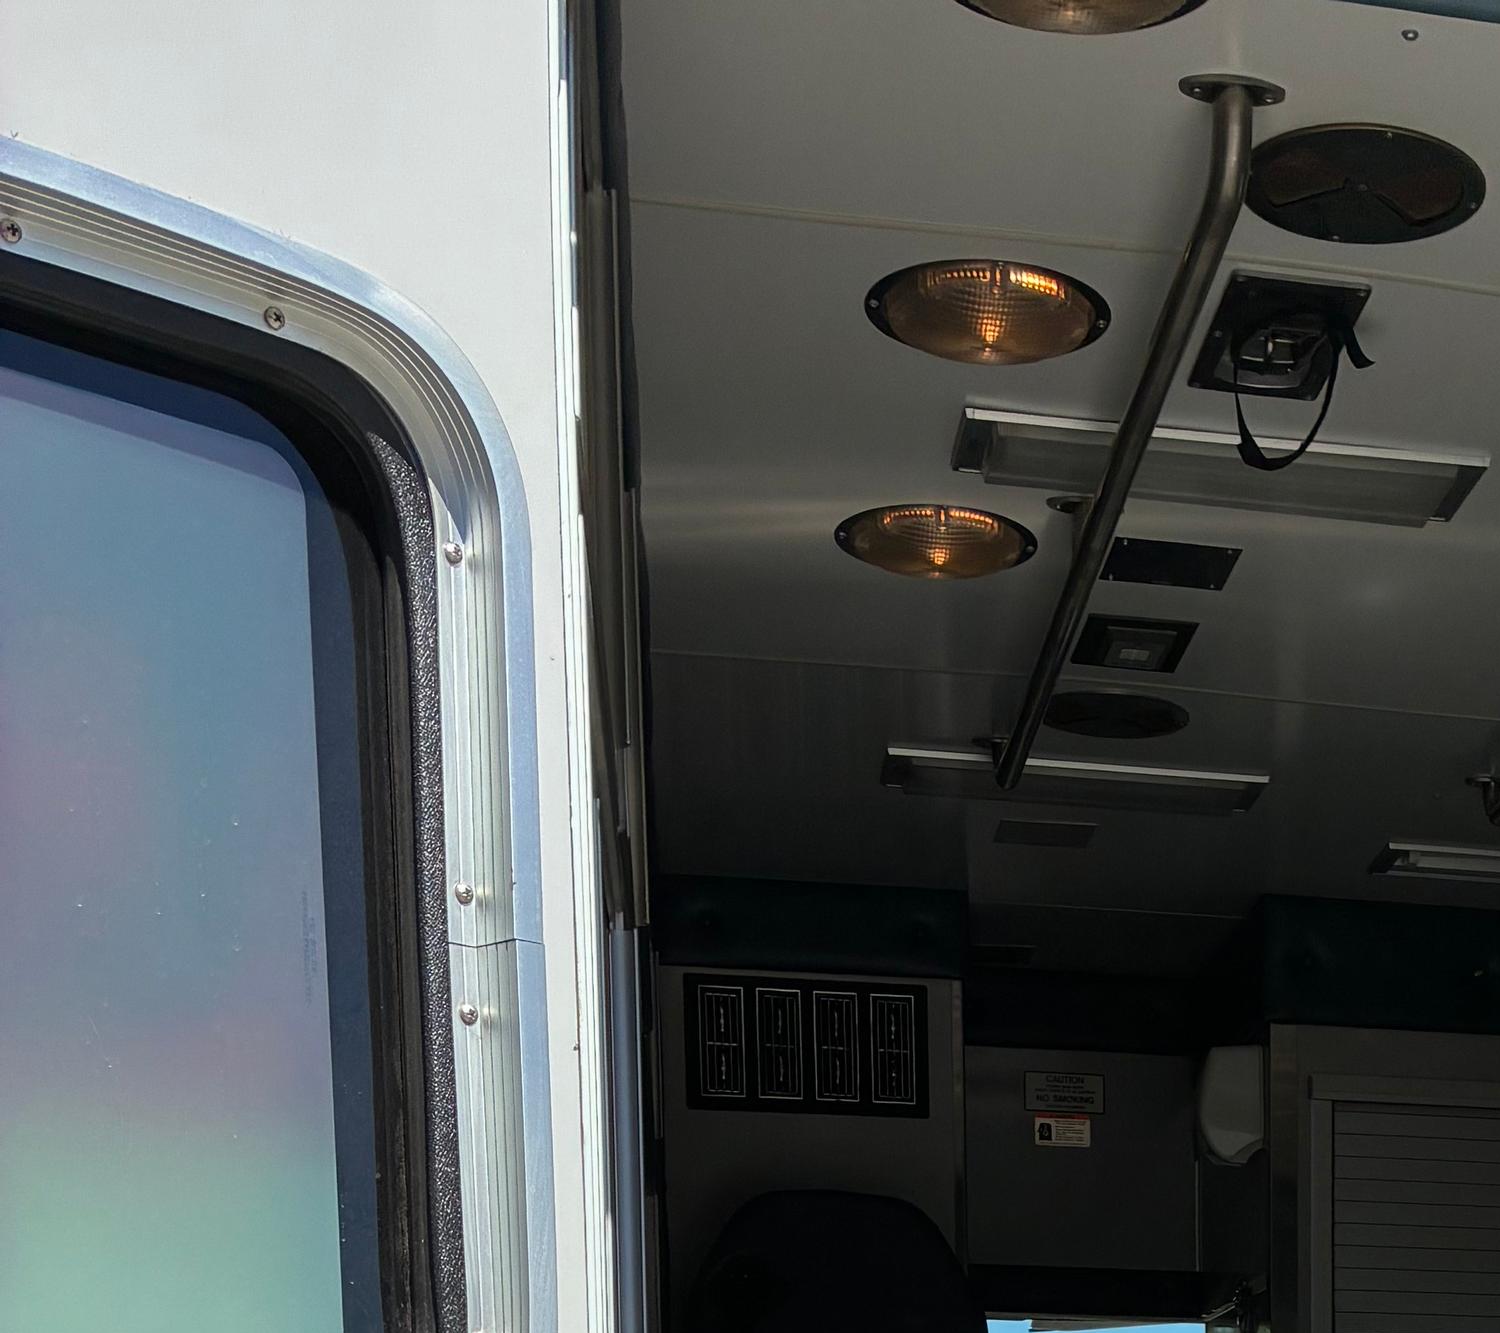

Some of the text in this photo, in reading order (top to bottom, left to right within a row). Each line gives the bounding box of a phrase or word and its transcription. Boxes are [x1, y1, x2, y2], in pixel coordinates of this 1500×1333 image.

[1046, 1074, 1085, 1084] CAUTION
[1036, 1094, 1095, 1105] NO SMOKING
